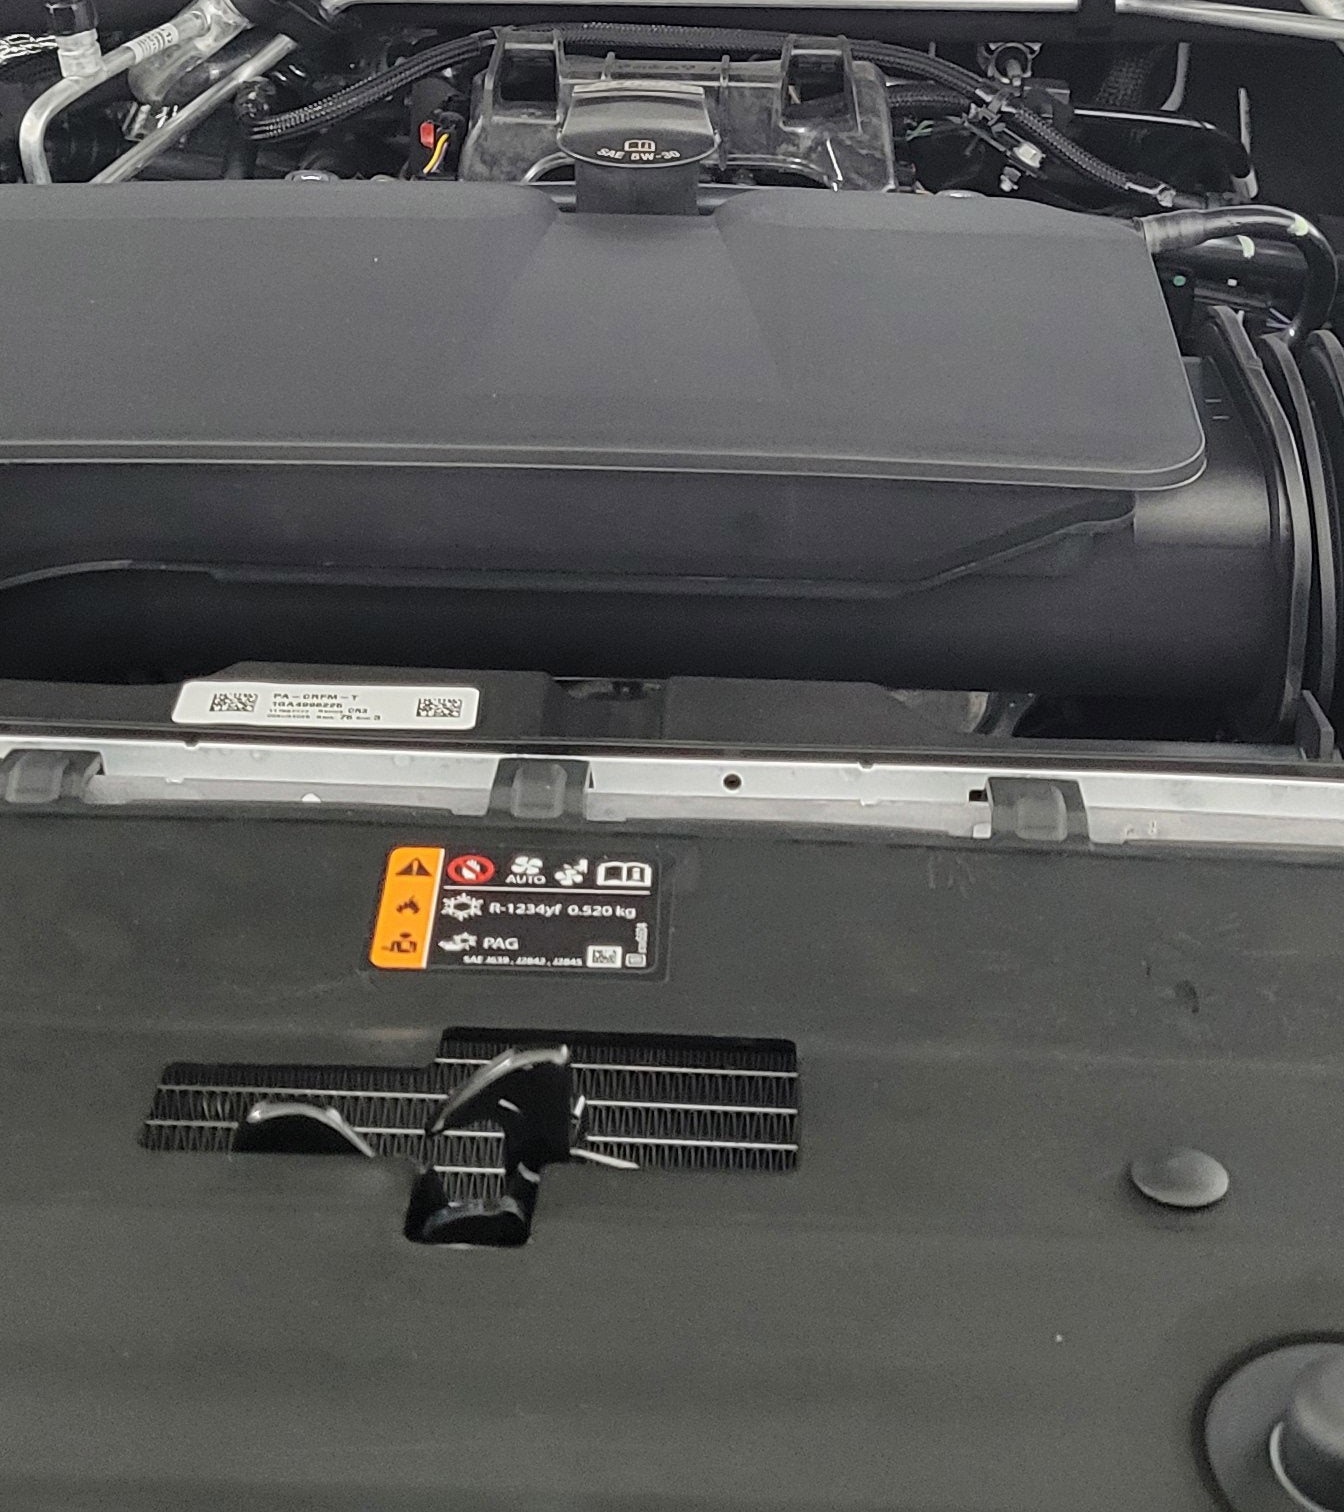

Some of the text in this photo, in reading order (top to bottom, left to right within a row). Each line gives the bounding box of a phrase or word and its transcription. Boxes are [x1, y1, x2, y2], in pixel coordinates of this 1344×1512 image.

[596, 147, 625, 160] SAE
[505, 874, 546, 885] AUTO
[488, 902, 636, 920] R-1234yf 0.520 kg
[482, 937, 519, 951] PAG
